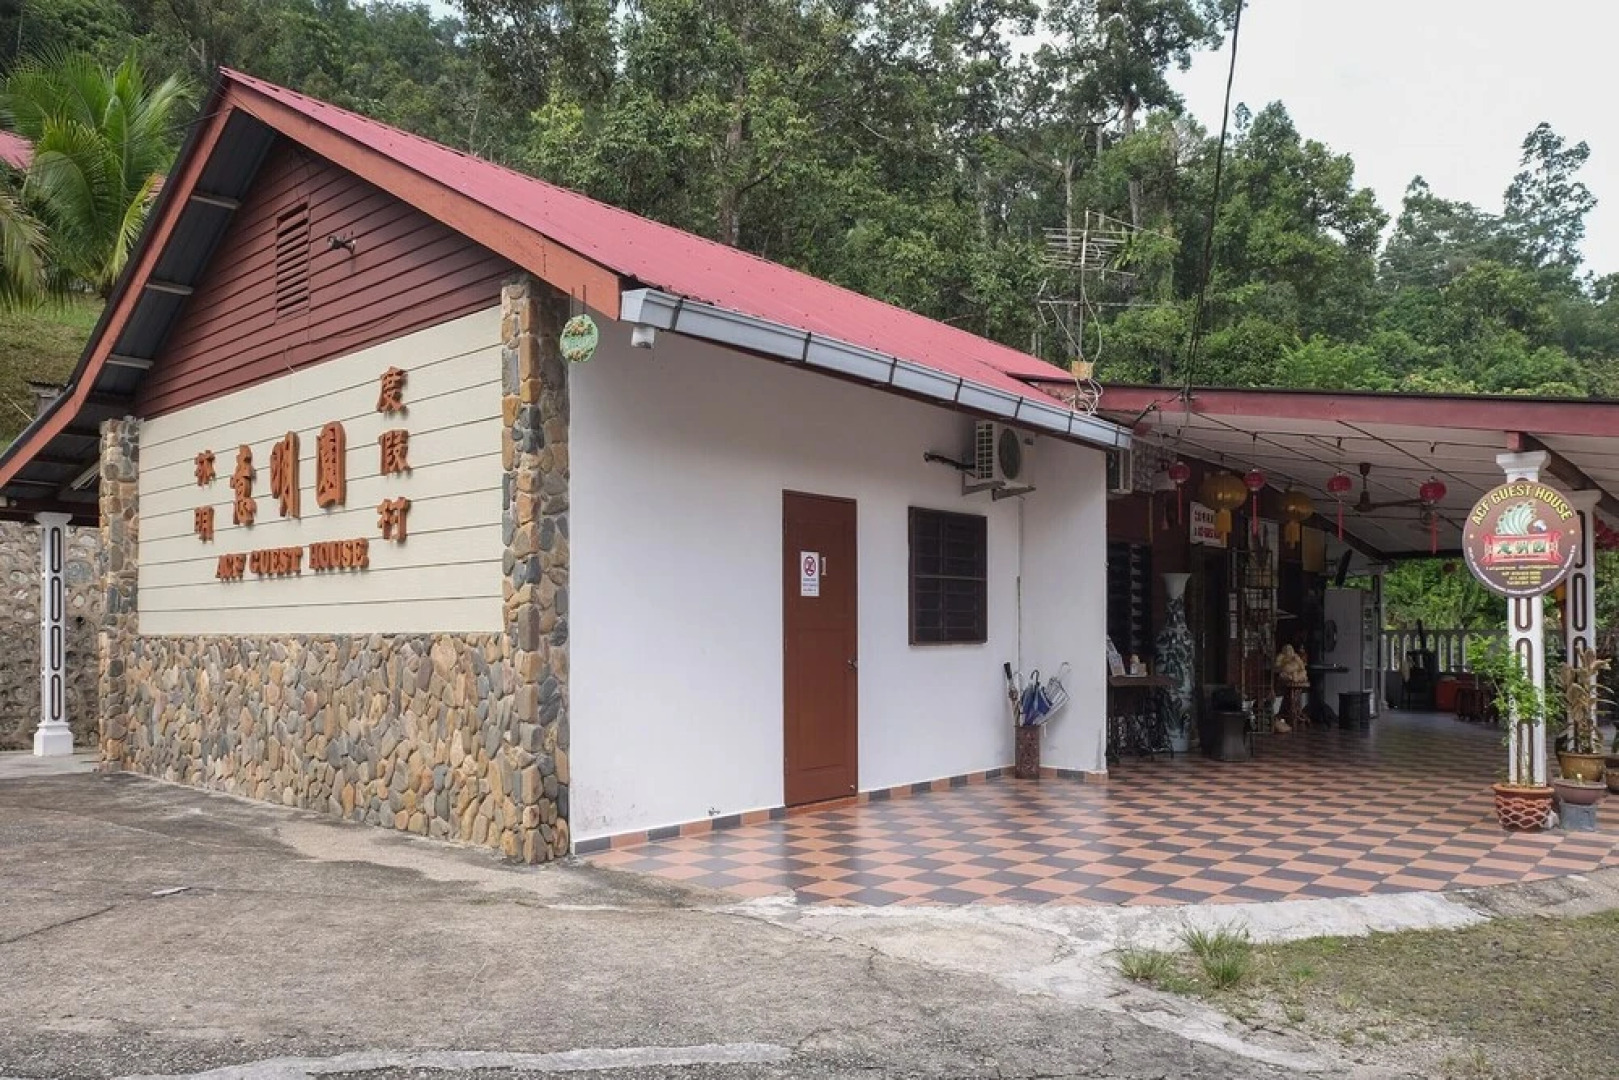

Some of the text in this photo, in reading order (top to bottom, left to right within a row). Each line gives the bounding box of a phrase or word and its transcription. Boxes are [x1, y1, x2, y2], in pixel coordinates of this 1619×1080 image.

[376, 366, 411, 541] 度假村
[1471, 485, 1573, 526] ACF GUEST HOUSE
[250, 546, 304, 574] GUEST
[309, 537, 370, 570] HOUSE
